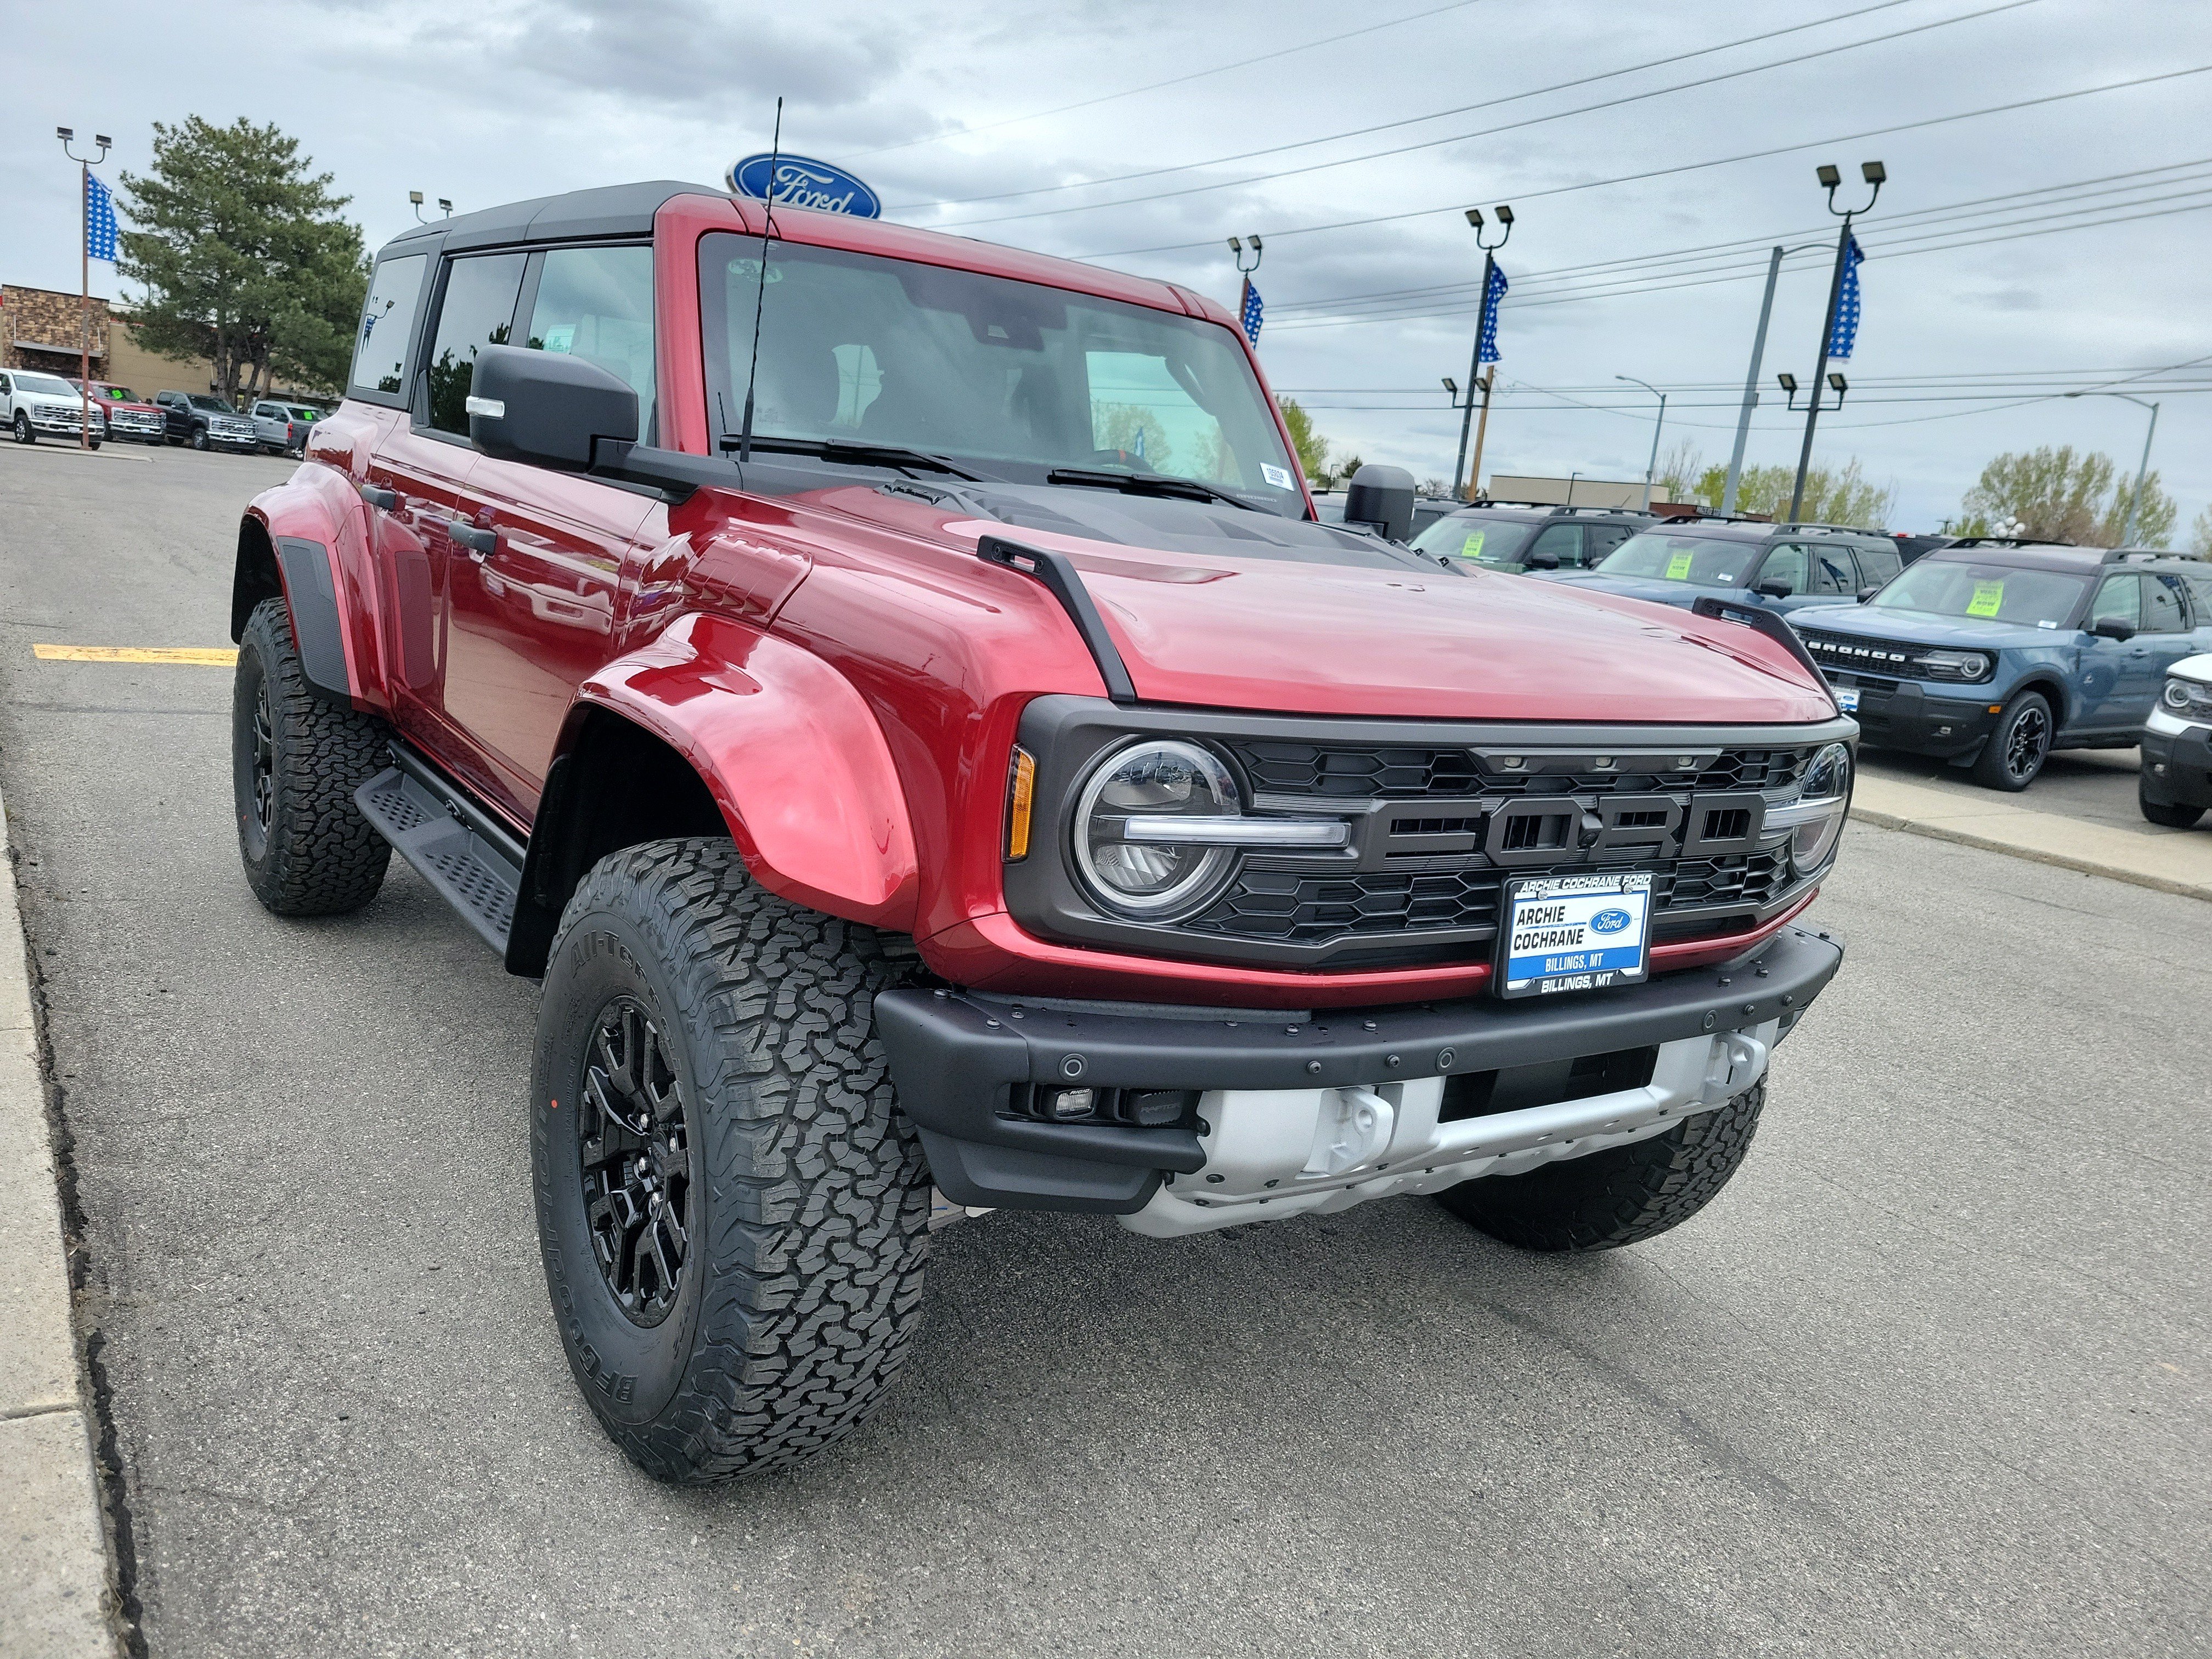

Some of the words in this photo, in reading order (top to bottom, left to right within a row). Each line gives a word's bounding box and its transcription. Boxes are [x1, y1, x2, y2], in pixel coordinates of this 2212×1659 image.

[766, 165, 855, 215] Ford
[1808, 640, 1906, 662] BRONCO
[1355, 792, 1764, 873] FORD
[1520, 879, 1560, 893] ARCHIE
[1561, 876, 1620, 889] COCHRANE
[1621, 874, 1652, 886] FORD
[1516, 905, 1566, 926] ARCHIE
[1597, 912, 1623, 930] Ford
[1514, 928, 1585, 951] COCHRANE
[1545, 955, 1587, 973] BILLINGS,
[1589, 952, 1604, 968] MT
[1541, 975, 1593, 994] BILLINGS,
[1595, 973, 1615, 987] MT
[1141, 1103, 1181, 1113] RAPTOR
